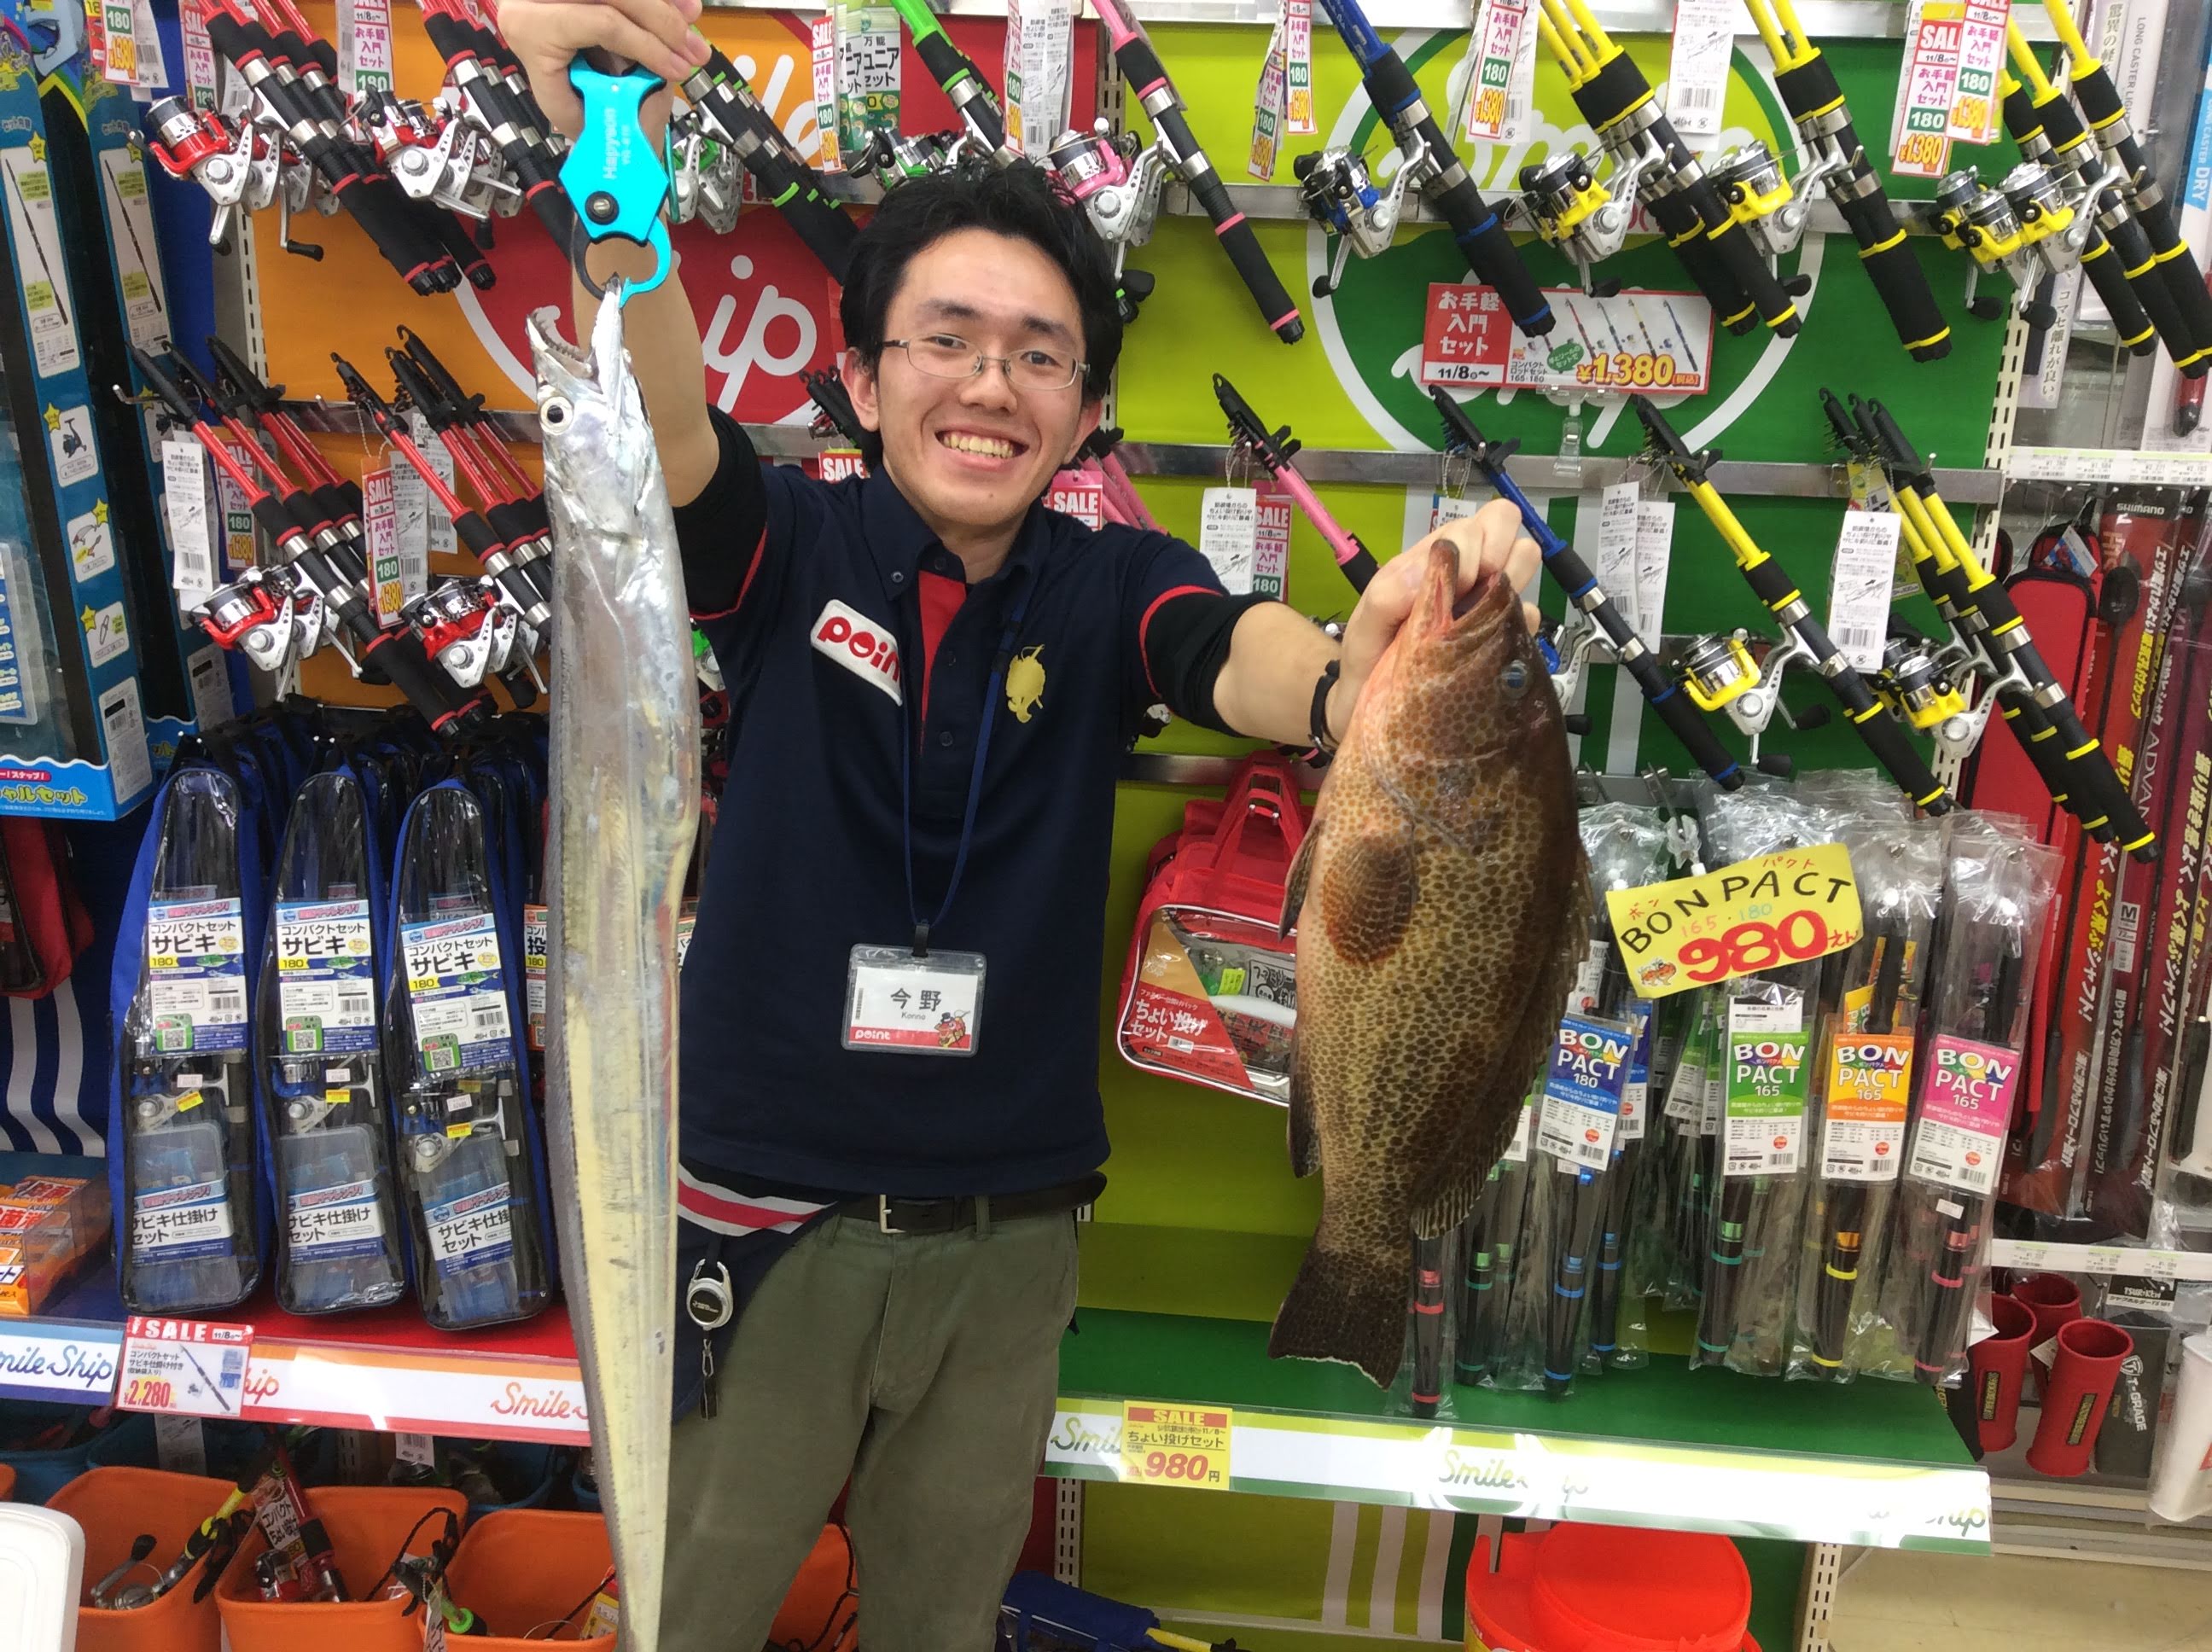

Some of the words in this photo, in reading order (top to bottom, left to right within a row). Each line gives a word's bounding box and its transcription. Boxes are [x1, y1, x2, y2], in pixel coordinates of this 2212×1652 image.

[108, 12, 130, 29] 180
[184, 10, 205, 34] SAL
[355, 28, 386, 41] お手軽
[1495, 27, 1512, 43] 入門
[1920, 25, 1960, 50] SAL
[1967, 26, 2000, 41] お手軽
[2134, 17, 2147, 45] LONG
[362, 42, 382, 54] 入門
[1291, 47, 1306, 60] セット
[1491, 42, 1511, 57] セット
[1970, 40, 1992, 53] 入門
[359, 56, 384, 68] セット
[1966, 53, 1991, 67] セット
[2128, 47, 2143, 89] CASTER
[195, 74, 212, 84] セット
[1289, 67, 1307, 83] 180
[1484, 62, 1507, 83] 180
[1918, 67, 1956, 81] お手軽
[1960, 72, 1990, 91] 180
[1008, 75, 1022, 100] 180
[1922, 81, 1947, 93] 入門
[1917, 94, 1947, 106] セット
[818, 108, 833, 125] 180
[1259, 112, 1273, 131] 180
[1911, 112, 1945, 128] 180
[2192, 166, 2211, 202] DRY
[1438, 291, 1500, 312] お手軽
[1447, 314, 1488, 334] 入門
[1440, 338, 1489, 357] セット
[1510, 368, 1548, 376] ロッドセット
[1511, 361, 1545, 369] コンパクト
[1576, 352, 1674, 387] ¥1,380
[822, 457, 864, 482] SALE
[368, 476, 392, 504] SALE
[1054, 491, 1099, 514] SALE
[2116, 503, 2165, 515] SHIMANO
[229, 516, 251, 530] 180
[378, 544, 395, 556] セット
[1259, 552, 1278, 563] 入門
[377, 561, 399, 579] 180
[1255, 563, 1278, 573] セット
[1253, 578, 1278, 593] 180
[817, 616, 901, 682] poin
[1761, 856, 1814, 870] パクト
[1621, 889, 1709, 953] BON
[1721, 870, 1852, 904] PACT
[151, 921, 236, 934] コンパクトセット
[282, 923, 366, 936] コンパクトセット
[152, 934, 216, 955] サビキ
[282, 936, 346, 957] サビキ
[409, 936, 493, 957] コンパクトセット
[153, 957, 173, 967] 180
[282, 958, 304, 969] 180
[410, 951, 475, 977] サビキ
[527, 957, 544, 968] 180
[413, 978, 434, 988] 180
[890, 987, 941, 1012] 今野
[1136, 998, 1208, 1036] ちょい投げ
[855, 1029, 891, 1040] point
[1130, 1021, 1168, 1043] セット
[1559, 1028, 1628, 1060] BON
[1733, 1042, 1806, 1062] BON
[1836, 1044, 1910, 1065] BON
[1557, 1049, 1621, 1080] PACT
[1936, 1048, 2012, 1082] BON
[1574, 1073, 1598, 1089] 180
[1736, 1064, 1801, 1085] PACT
[1837, 1067, 1904, 1088] PACT
[1755, 1085, 1780, 1097] 165
[1856, 1088, 1883, 1101] 165
[1935, 1069, 2005, 1102] PACT
[1953, 1093, 1980, 1111] 165
[133, 1207, 218, 1233] サビキ仕掛け
[288, 1207, 371, 1231] サビキ仕掛け
[437, 1207, 511, 1239] サビキ仕掛
[132, 1230, 169, 1246] セット
[288, 1229, 326, 1244] セット
[442, 1232, 482, 1253] セット
[144, 1319, 207, 1342] SALE
[130, 1350, 180, 1361] コンパクトセット
[49, 1344, 113, 1388] Ship
[491, 1382, 571, 1419] Smile
[2128, 1376, 2147, 1432] T-GRADE
[1153, 1409, 1205, 1426] SALE
[1051, 1416, 1121, 1453] Smil
[1127, 1430, 1225, 1448] ちょい投げセット
[1438, 1449, 1516, 1489] Smile
